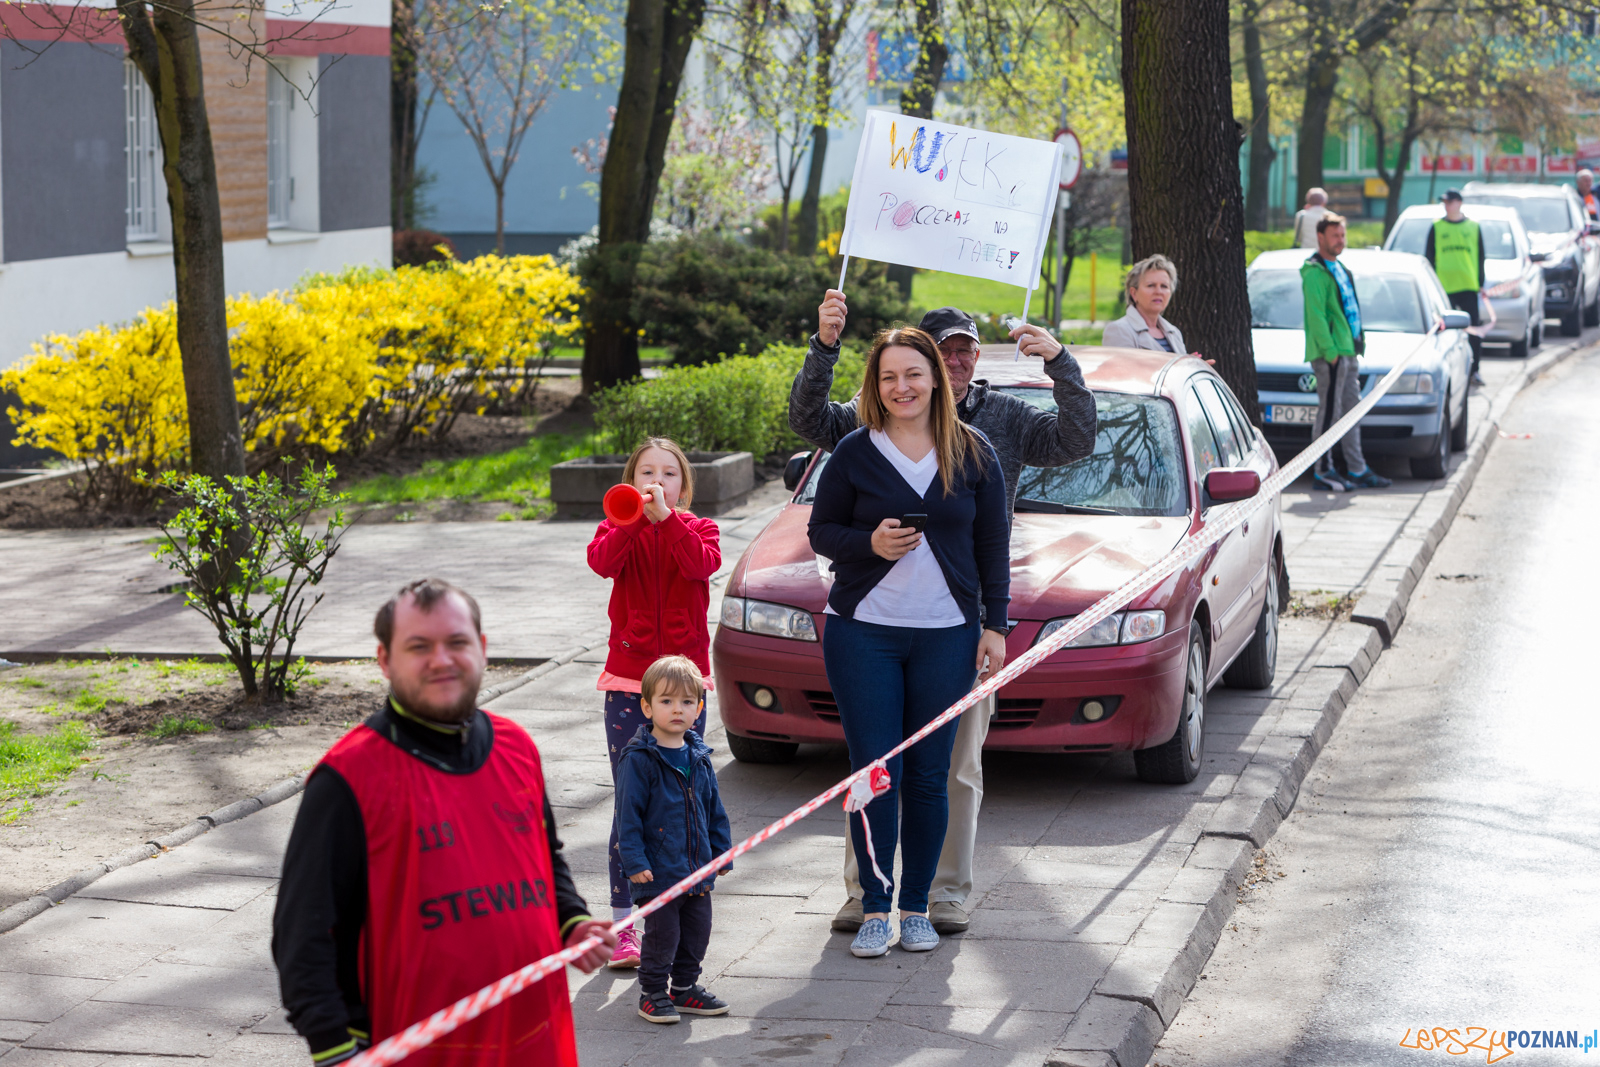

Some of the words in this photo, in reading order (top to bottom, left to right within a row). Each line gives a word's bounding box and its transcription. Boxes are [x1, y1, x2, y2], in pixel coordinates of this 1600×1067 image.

[993, 221, 1009, 235] NA
[1274, 406, 1295, 421] PO
[417, 821, 455, 853] 119
